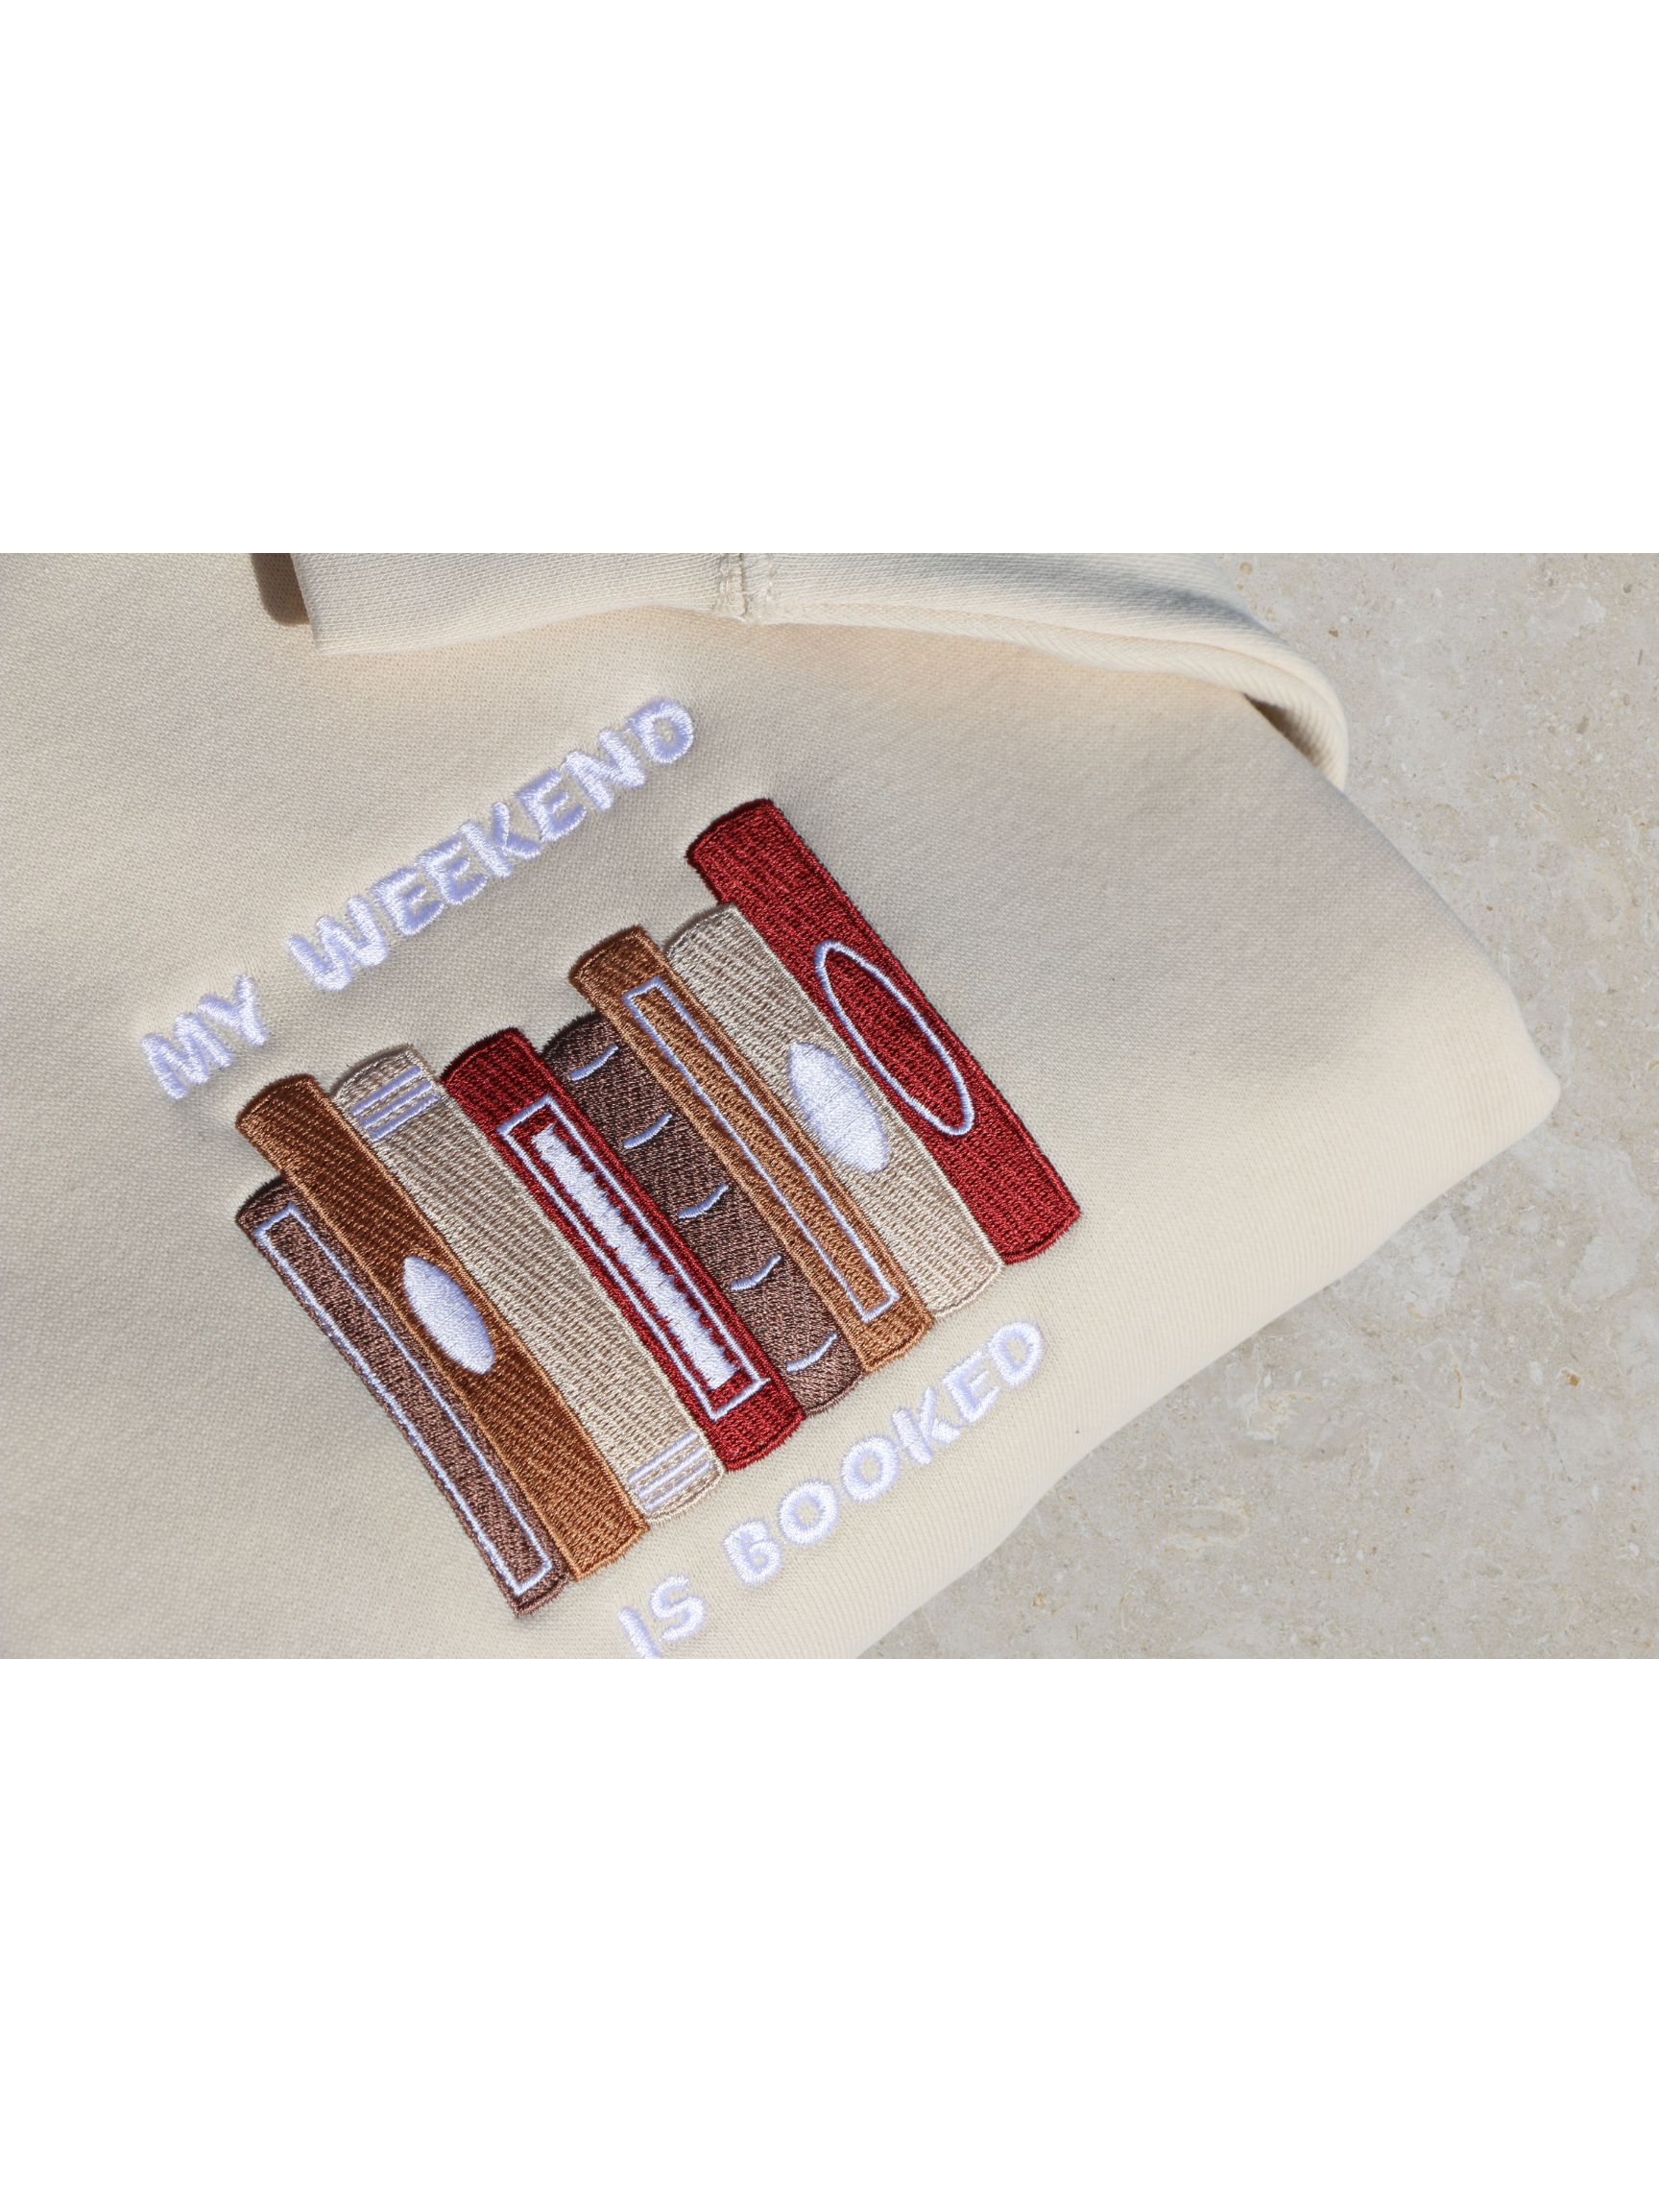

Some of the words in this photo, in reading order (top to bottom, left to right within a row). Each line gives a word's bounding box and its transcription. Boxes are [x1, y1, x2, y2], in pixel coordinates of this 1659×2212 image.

[141, 974, 269, 1100] MY
[287, 698, 695, 992] WEEKEND
[617, 1573, 708, 1659] IS
[721, 1320, 1045, 1586] BOOKED
